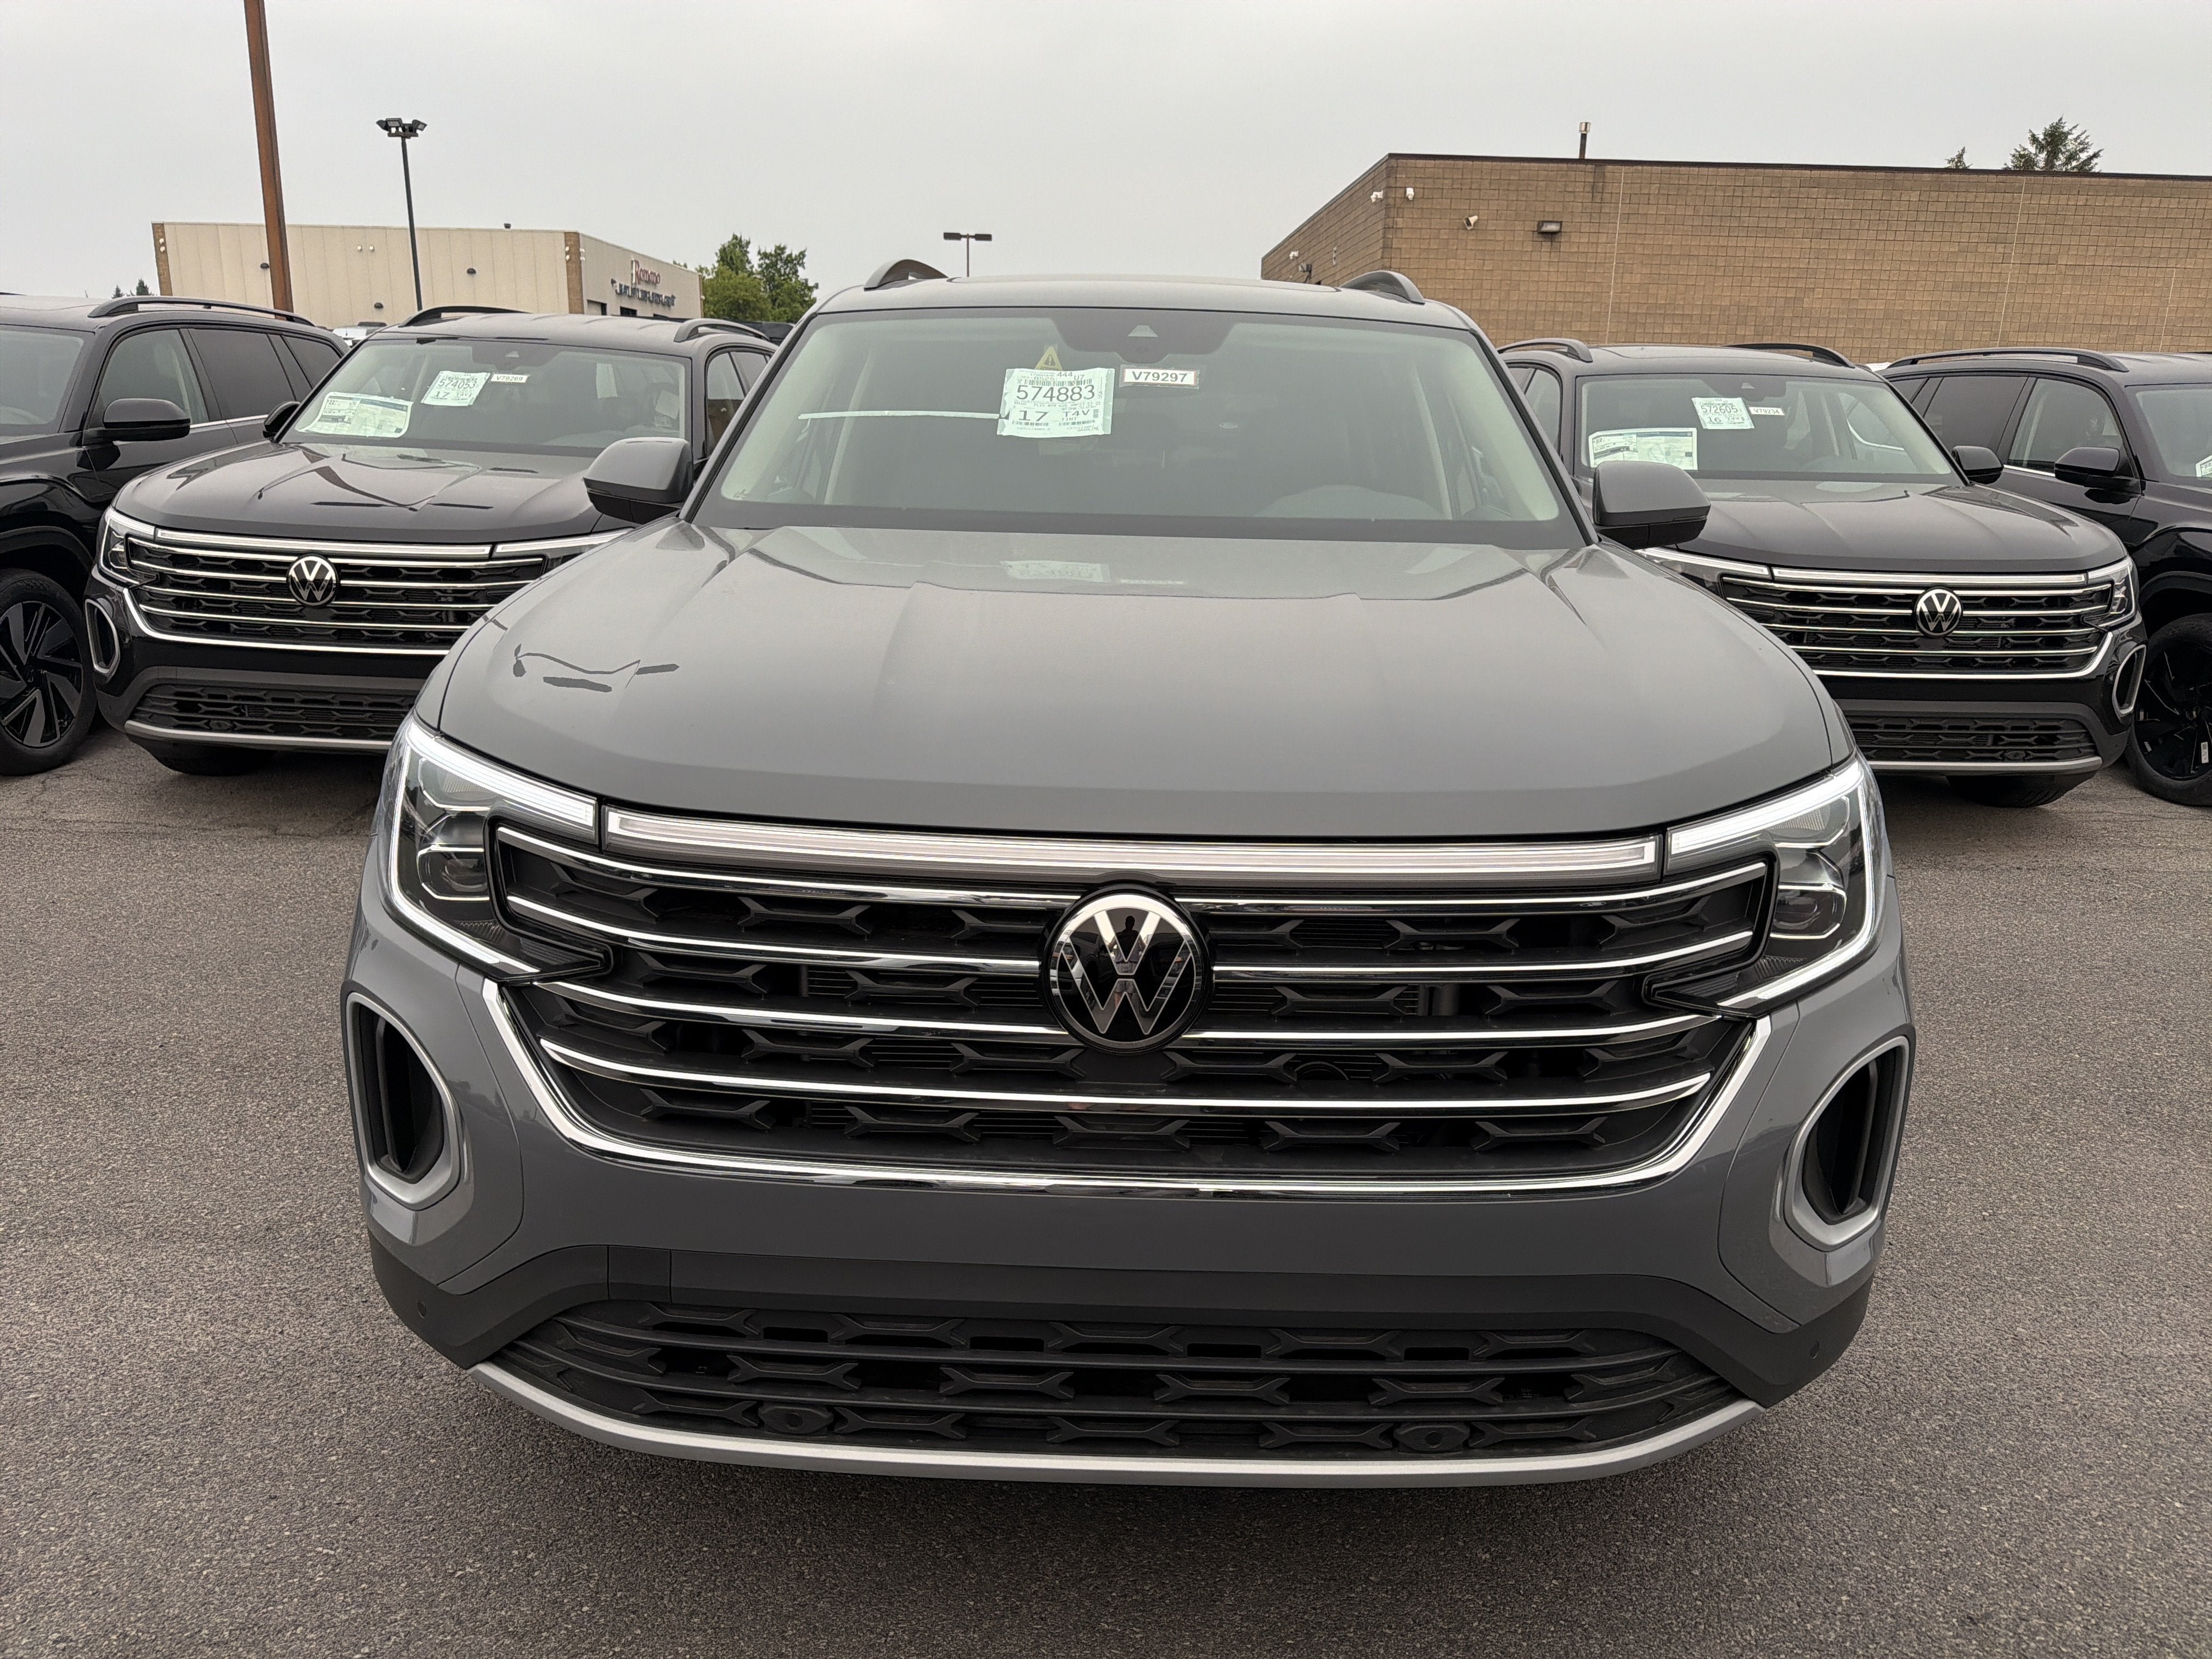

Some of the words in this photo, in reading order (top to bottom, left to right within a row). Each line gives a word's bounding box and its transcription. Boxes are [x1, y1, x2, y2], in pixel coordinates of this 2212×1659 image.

[1132, 371, 1187, 382] V79297
[438, 379, 477, 389] 574053
[1016, 385, 1095, 402] 574883
[1018, 410, 1049, 421] 17
[1062, 409, 1090, 417] T4V
[1060, 906, 1193, 1035] VW
